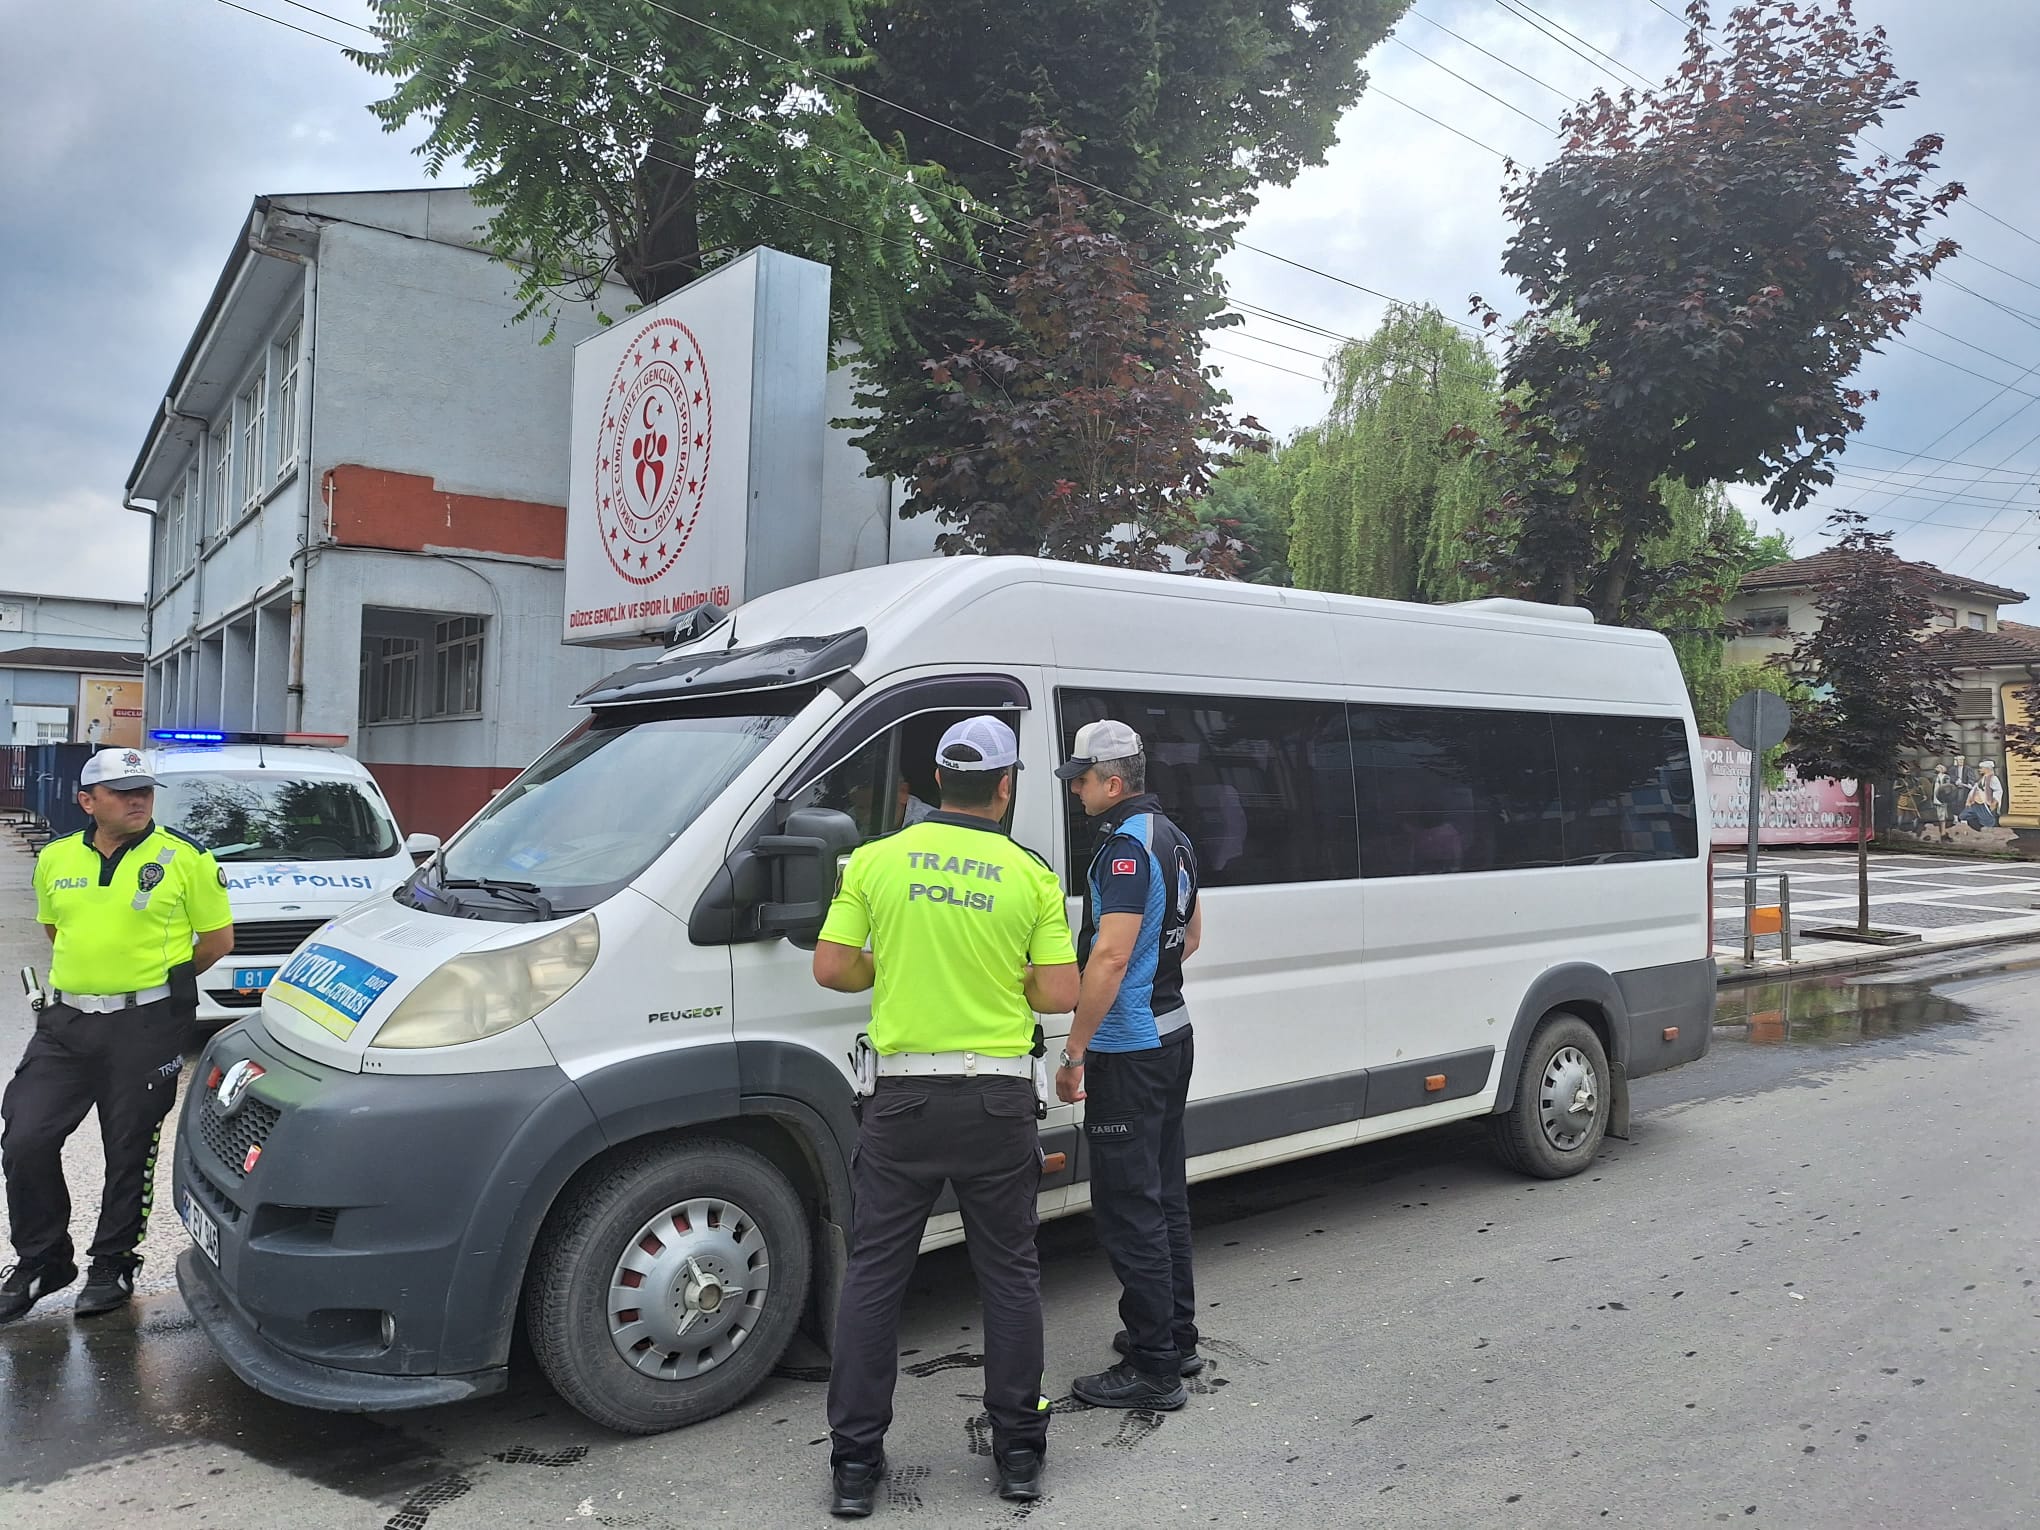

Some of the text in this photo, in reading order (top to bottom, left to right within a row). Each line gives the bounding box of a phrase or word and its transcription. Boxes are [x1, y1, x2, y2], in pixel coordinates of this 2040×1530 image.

[643, 368, 675, 388] GENÇLİK
[673, 381, 684, 403] VE
[614, 378, 643, 484] CUMHURİYETİ
[679, 402, 689, 446] SPOR
[654, 451, 687, 530] BAKANLIĞI
[569, 609, 594, 628] DÜZCE
[594, 602, 626, 626] GENÇLİK
[628, 602, 639, 620] VE
[639, 599, 662, 618] SPOR
[662, 594, 671, 615] İL
[244, 971, 264, 987] 81
[648, 1006, 724, 1024] PEUGEOT
